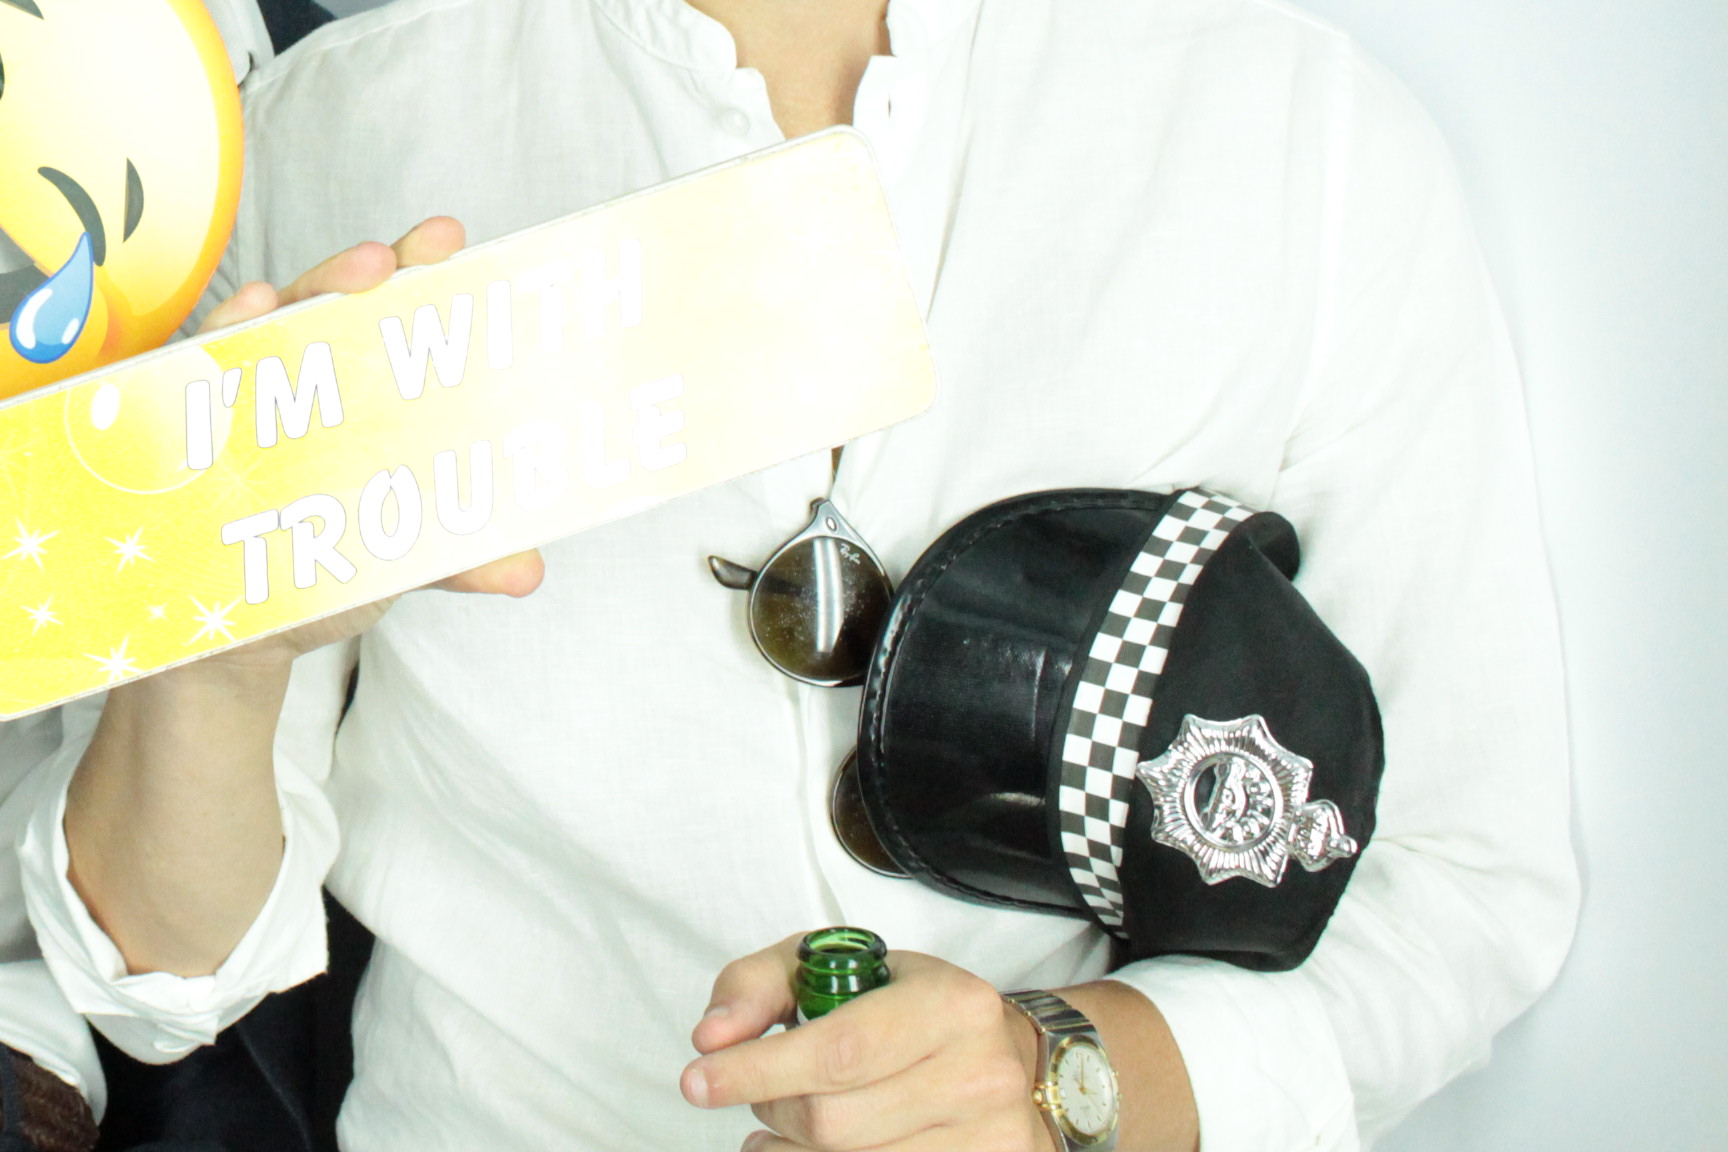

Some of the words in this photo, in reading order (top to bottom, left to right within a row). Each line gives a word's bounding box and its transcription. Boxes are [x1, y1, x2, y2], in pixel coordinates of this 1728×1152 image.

[186, 342, 344, 470] I'M
[379, 239, 643, 400] WITH
[221, 373, 688, 604] TROUBLE
